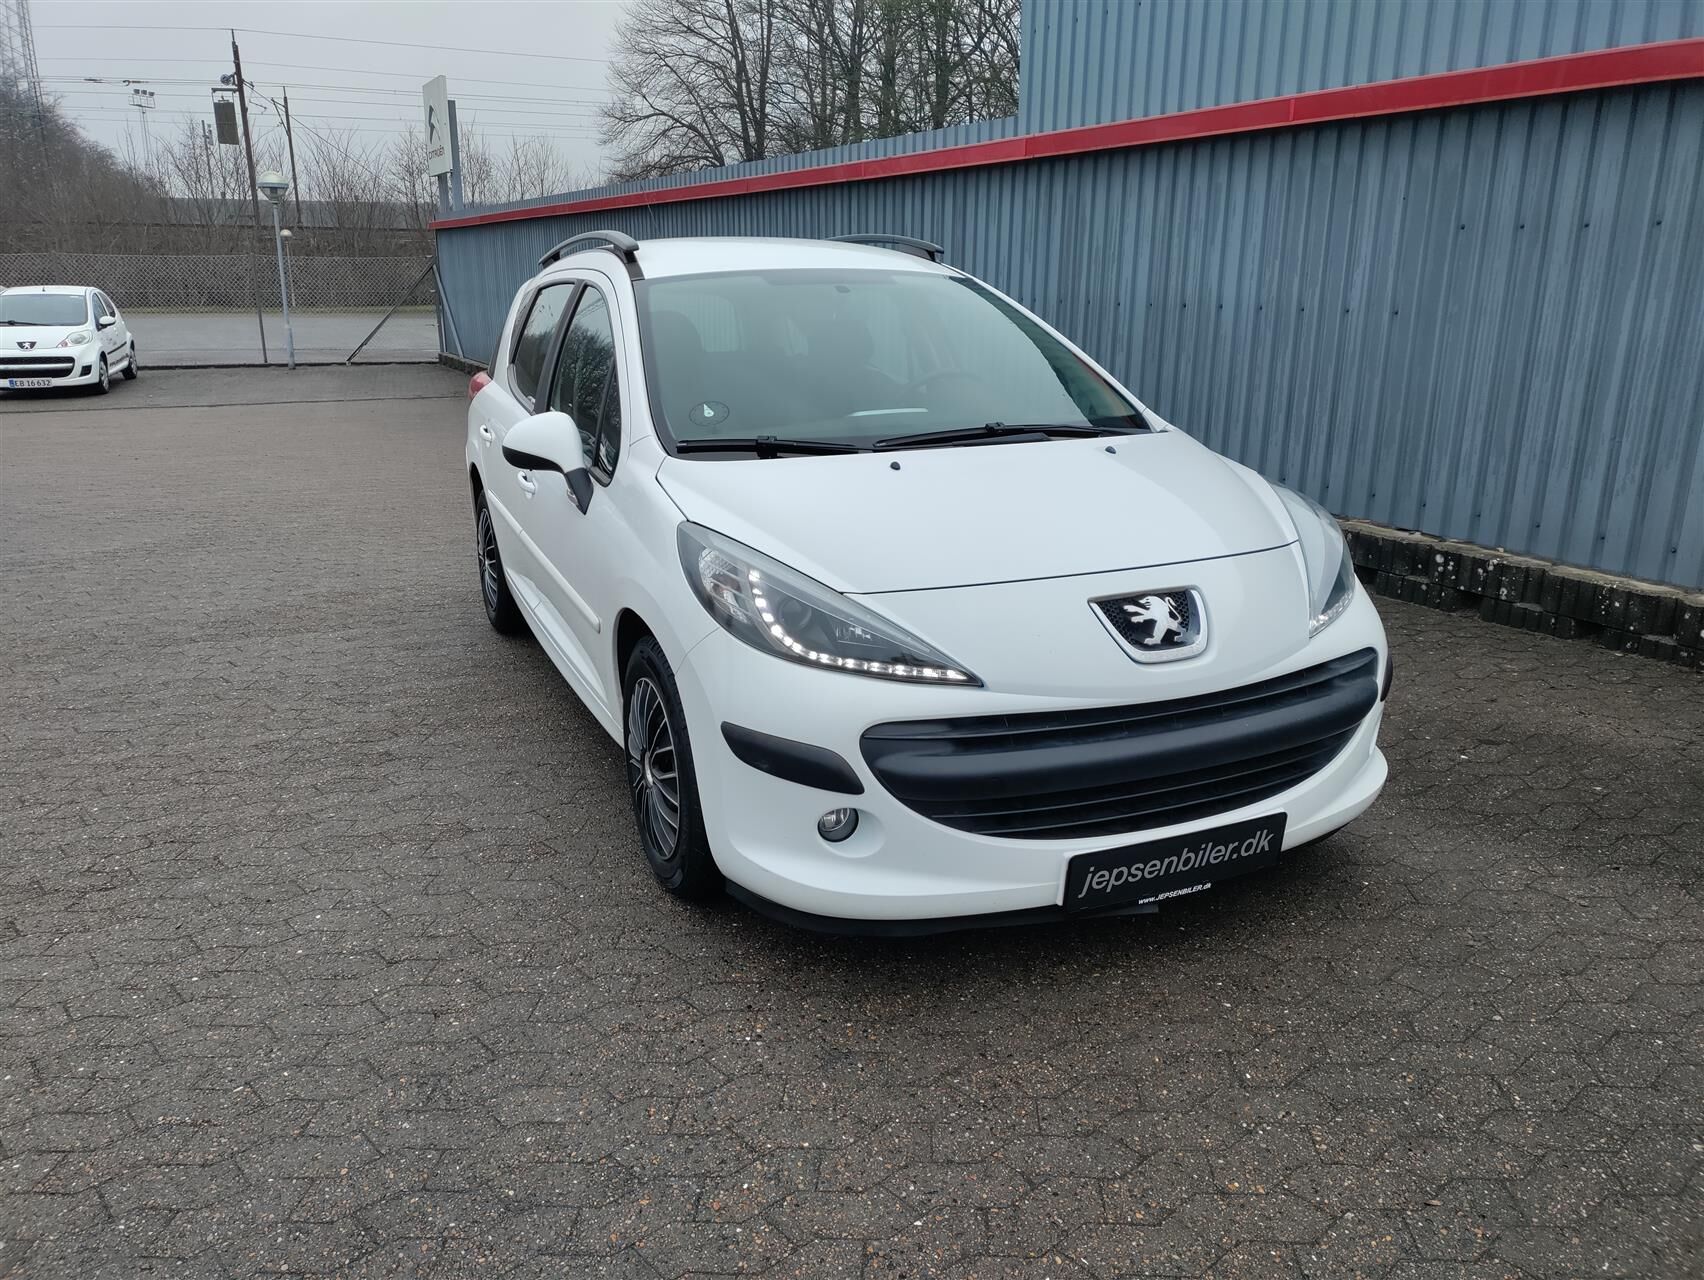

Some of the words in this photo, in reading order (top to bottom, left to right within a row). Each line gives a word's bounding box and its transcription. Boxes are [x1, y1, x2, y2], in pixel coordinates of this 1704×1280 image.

[36, 379, 51, 387] 632
[1078, 830, 1274, 898] jepsenbiler.dk
[1138, 882, 1212, 905] www.JEPSENBILER.dk
